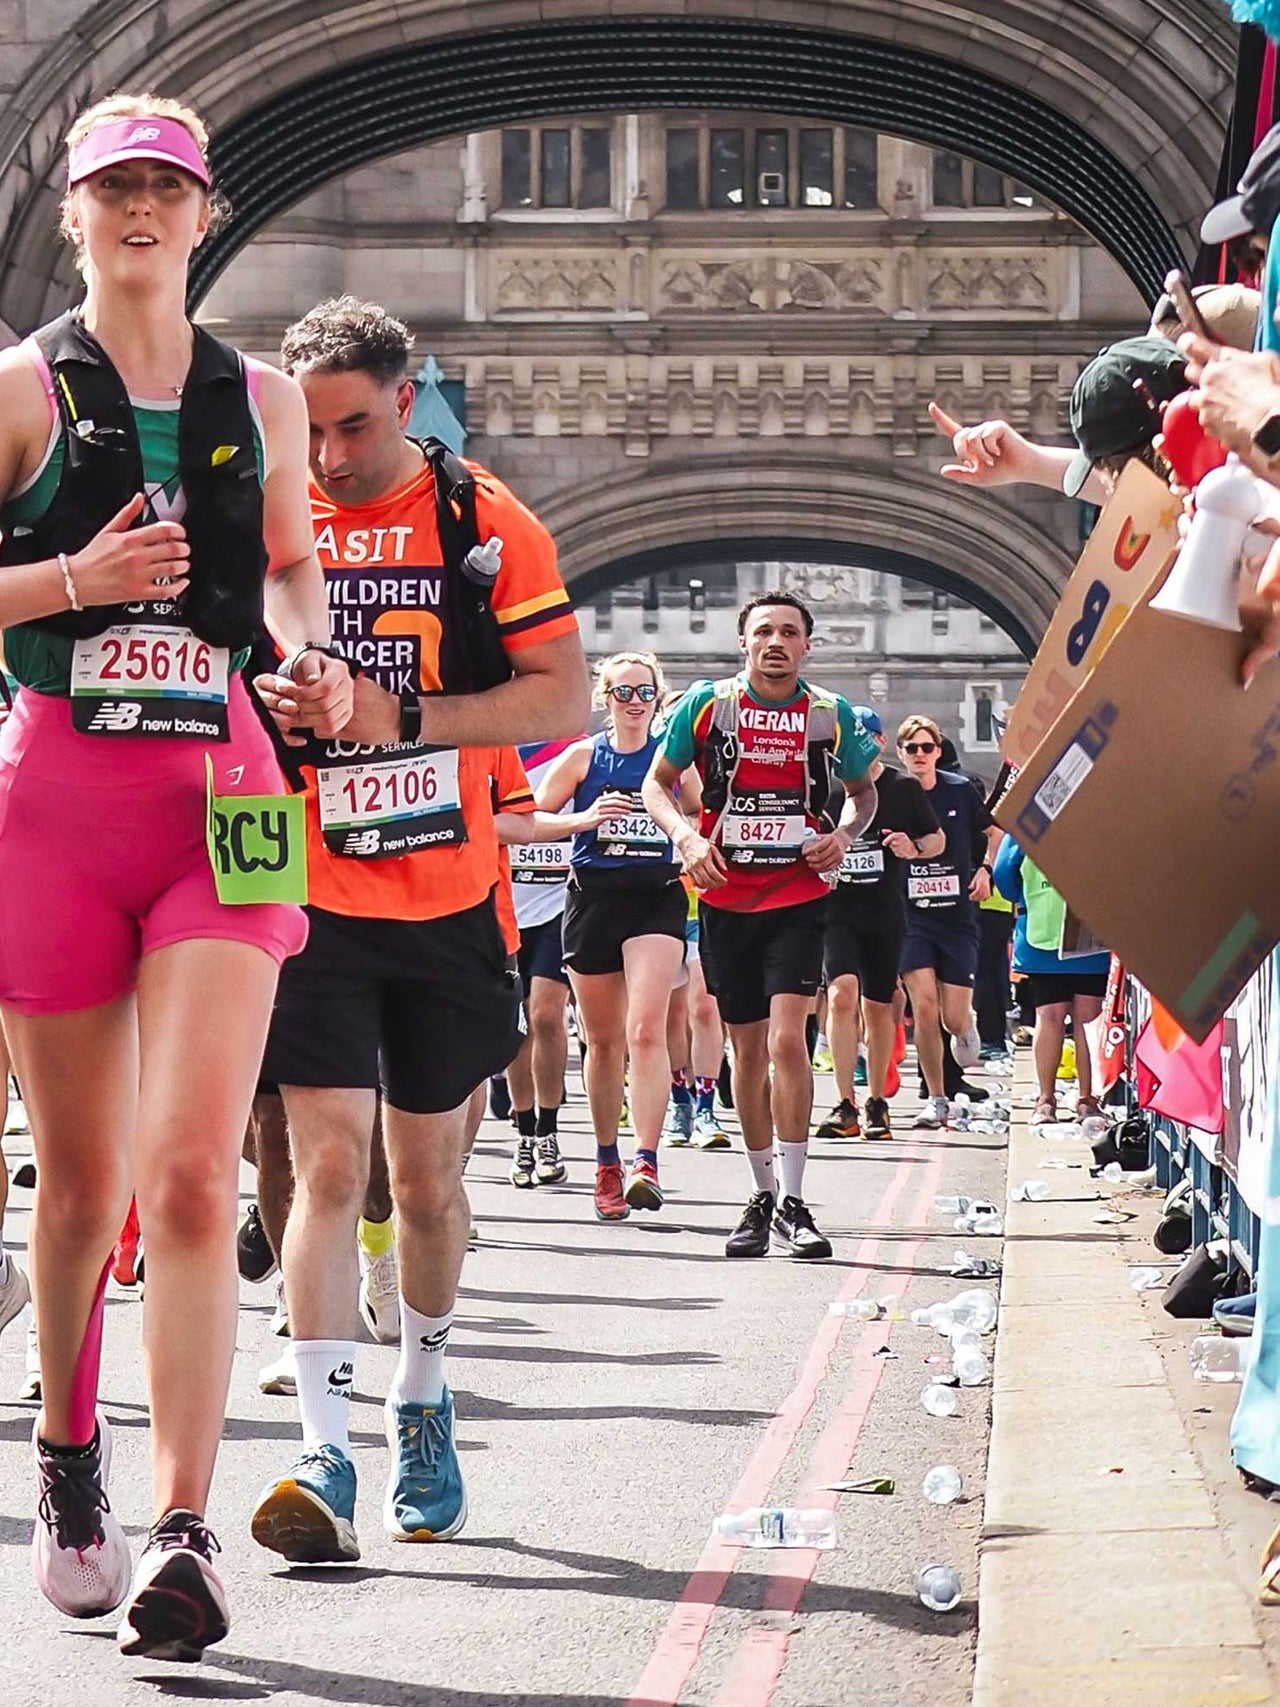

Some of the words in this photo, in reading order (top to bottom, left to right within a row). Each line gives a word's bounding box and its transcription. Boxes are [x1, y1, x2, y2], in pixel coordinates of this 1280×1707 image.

[329, 609, 363, 636] TH
[99, 639, 211, 684] 25616
[335, 640, 414, 667] NCER
[142, 718, 172, 732] new
[174, 717, 220, 736] balance
[739, 707, 805, 733] KIERAN
[753, 735, 796, 747] London's
[342, 766, 438, 815] 12106
[382, 837, 406, 852] new
[407, 827, 455, 846] balance
[609, 818, 657, 837] 53423
[740, 822, 787, 841] 8427
[519, 848, 562, 863] 54198
